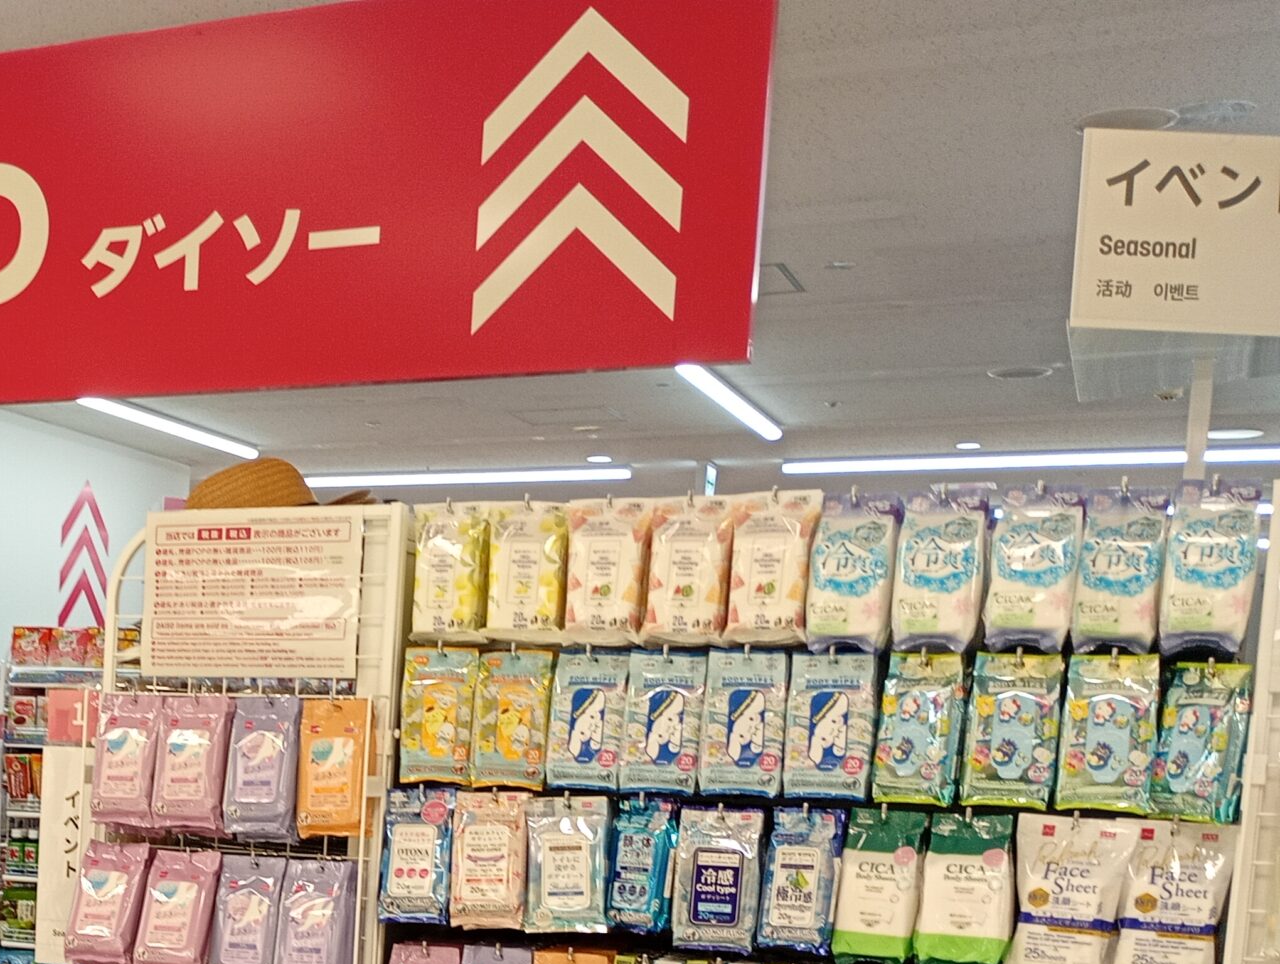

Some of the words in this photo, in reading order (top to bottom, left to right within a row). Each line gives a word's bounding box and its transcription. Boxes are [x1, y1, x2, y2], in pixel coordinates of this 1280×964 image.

[1106, 158, 1280, 213] イベン
[81, 207, 381, 298] ダイソー
[1098, 234, 1198, 260] Seasonal
[1096, 279, 1132, 299] 活动
[1153, 282, 1199, 301] 이벤트
[64, 790, 81, 879] イベント
[700, 867, 734, 885] 冷感
[858, 861, 895, 874] CICA
[946, 863, 986, 875] CICA
[1043, 861, 1091, 880] Face
[1150, 865, 1198, 885] Face
[1051, 877, 1098, 896] Sheet
[1159, 882, 1208, 900] Sheet
